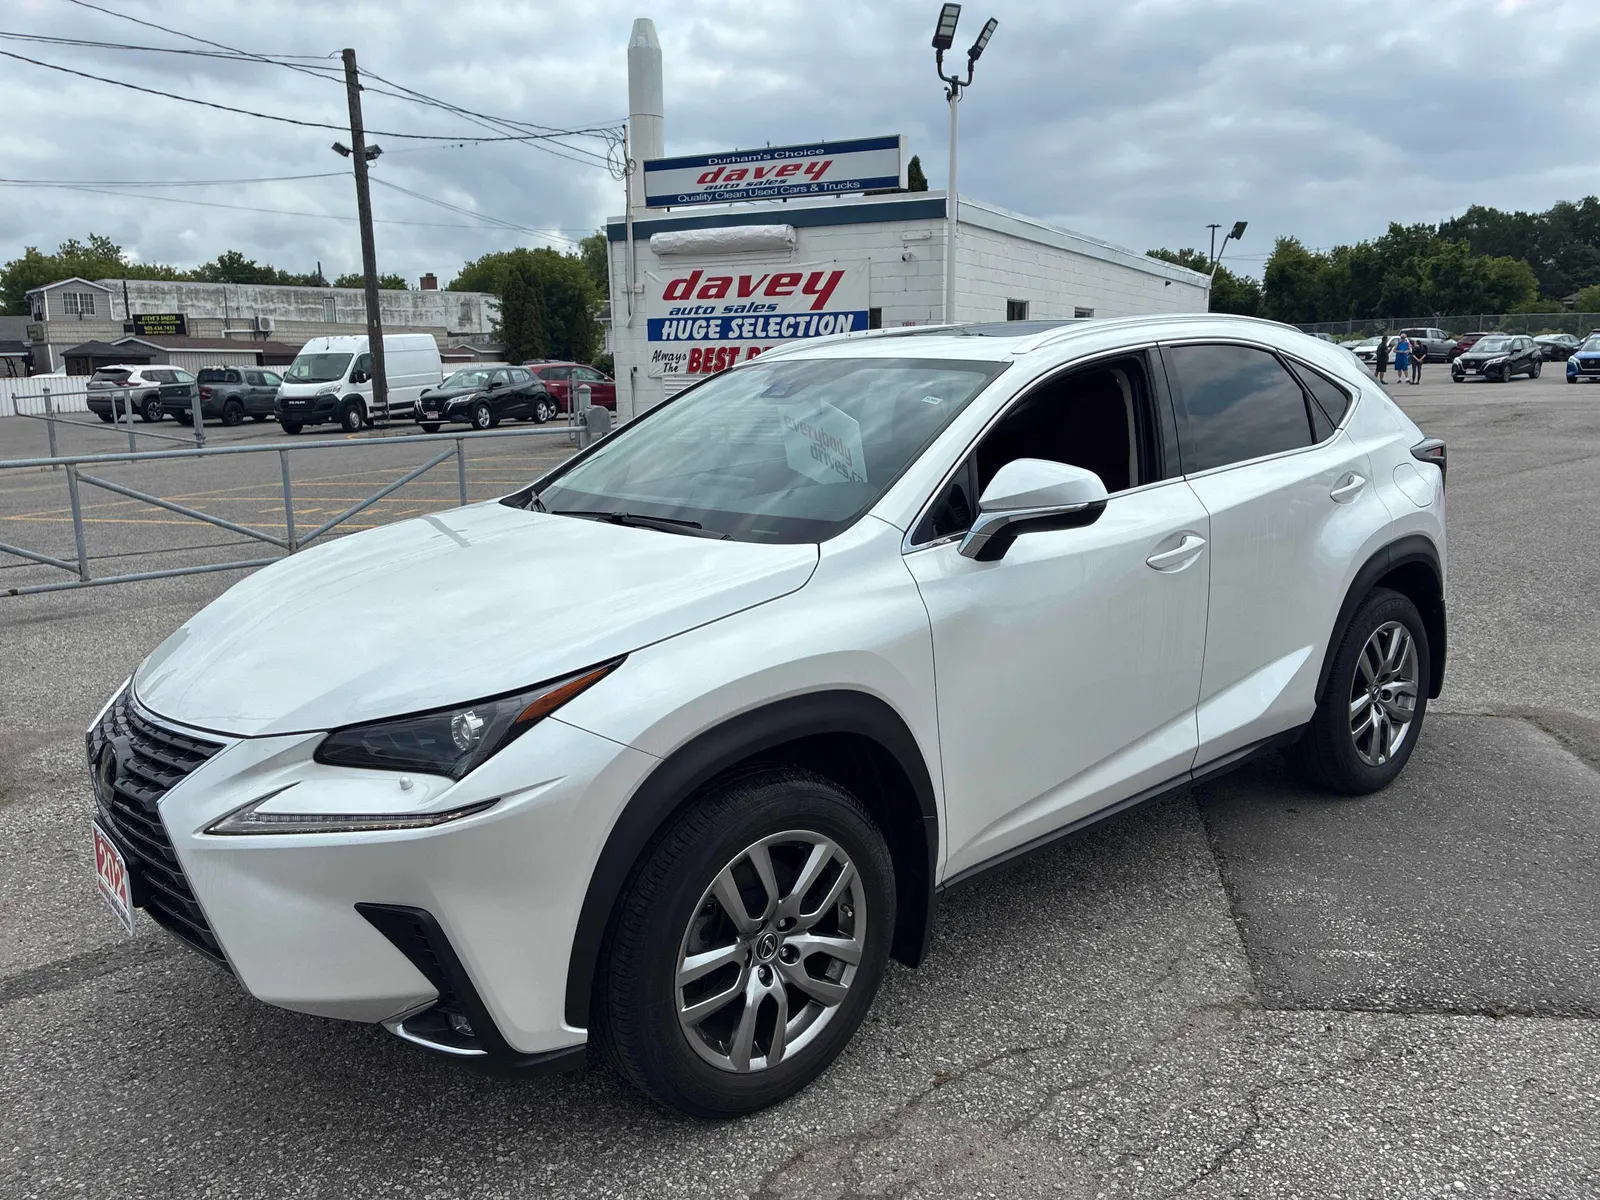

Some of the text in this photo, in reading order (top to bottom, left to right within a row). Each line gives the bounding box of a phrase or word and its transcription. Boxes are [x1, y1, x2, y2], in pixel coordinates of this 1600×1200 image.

[708, 147, 825, 165] Durham's Choice
[696, 159, 834, 184] davey
[677, 179, 861, 203] Quality Clean Used Cars & Trucks
[704, 178, 788, 191] auto sales
[662, 269, 846, 311] davey
[669, 301, 779, 316] auto sales
[661, 313, 855, 340] HUGE SELECTION
[652, 349, 687, 364] Always
[663, 362, 679, 373] The
[686, 347, 741, 374] BEST
[783, 415, 853, 467] everybody
